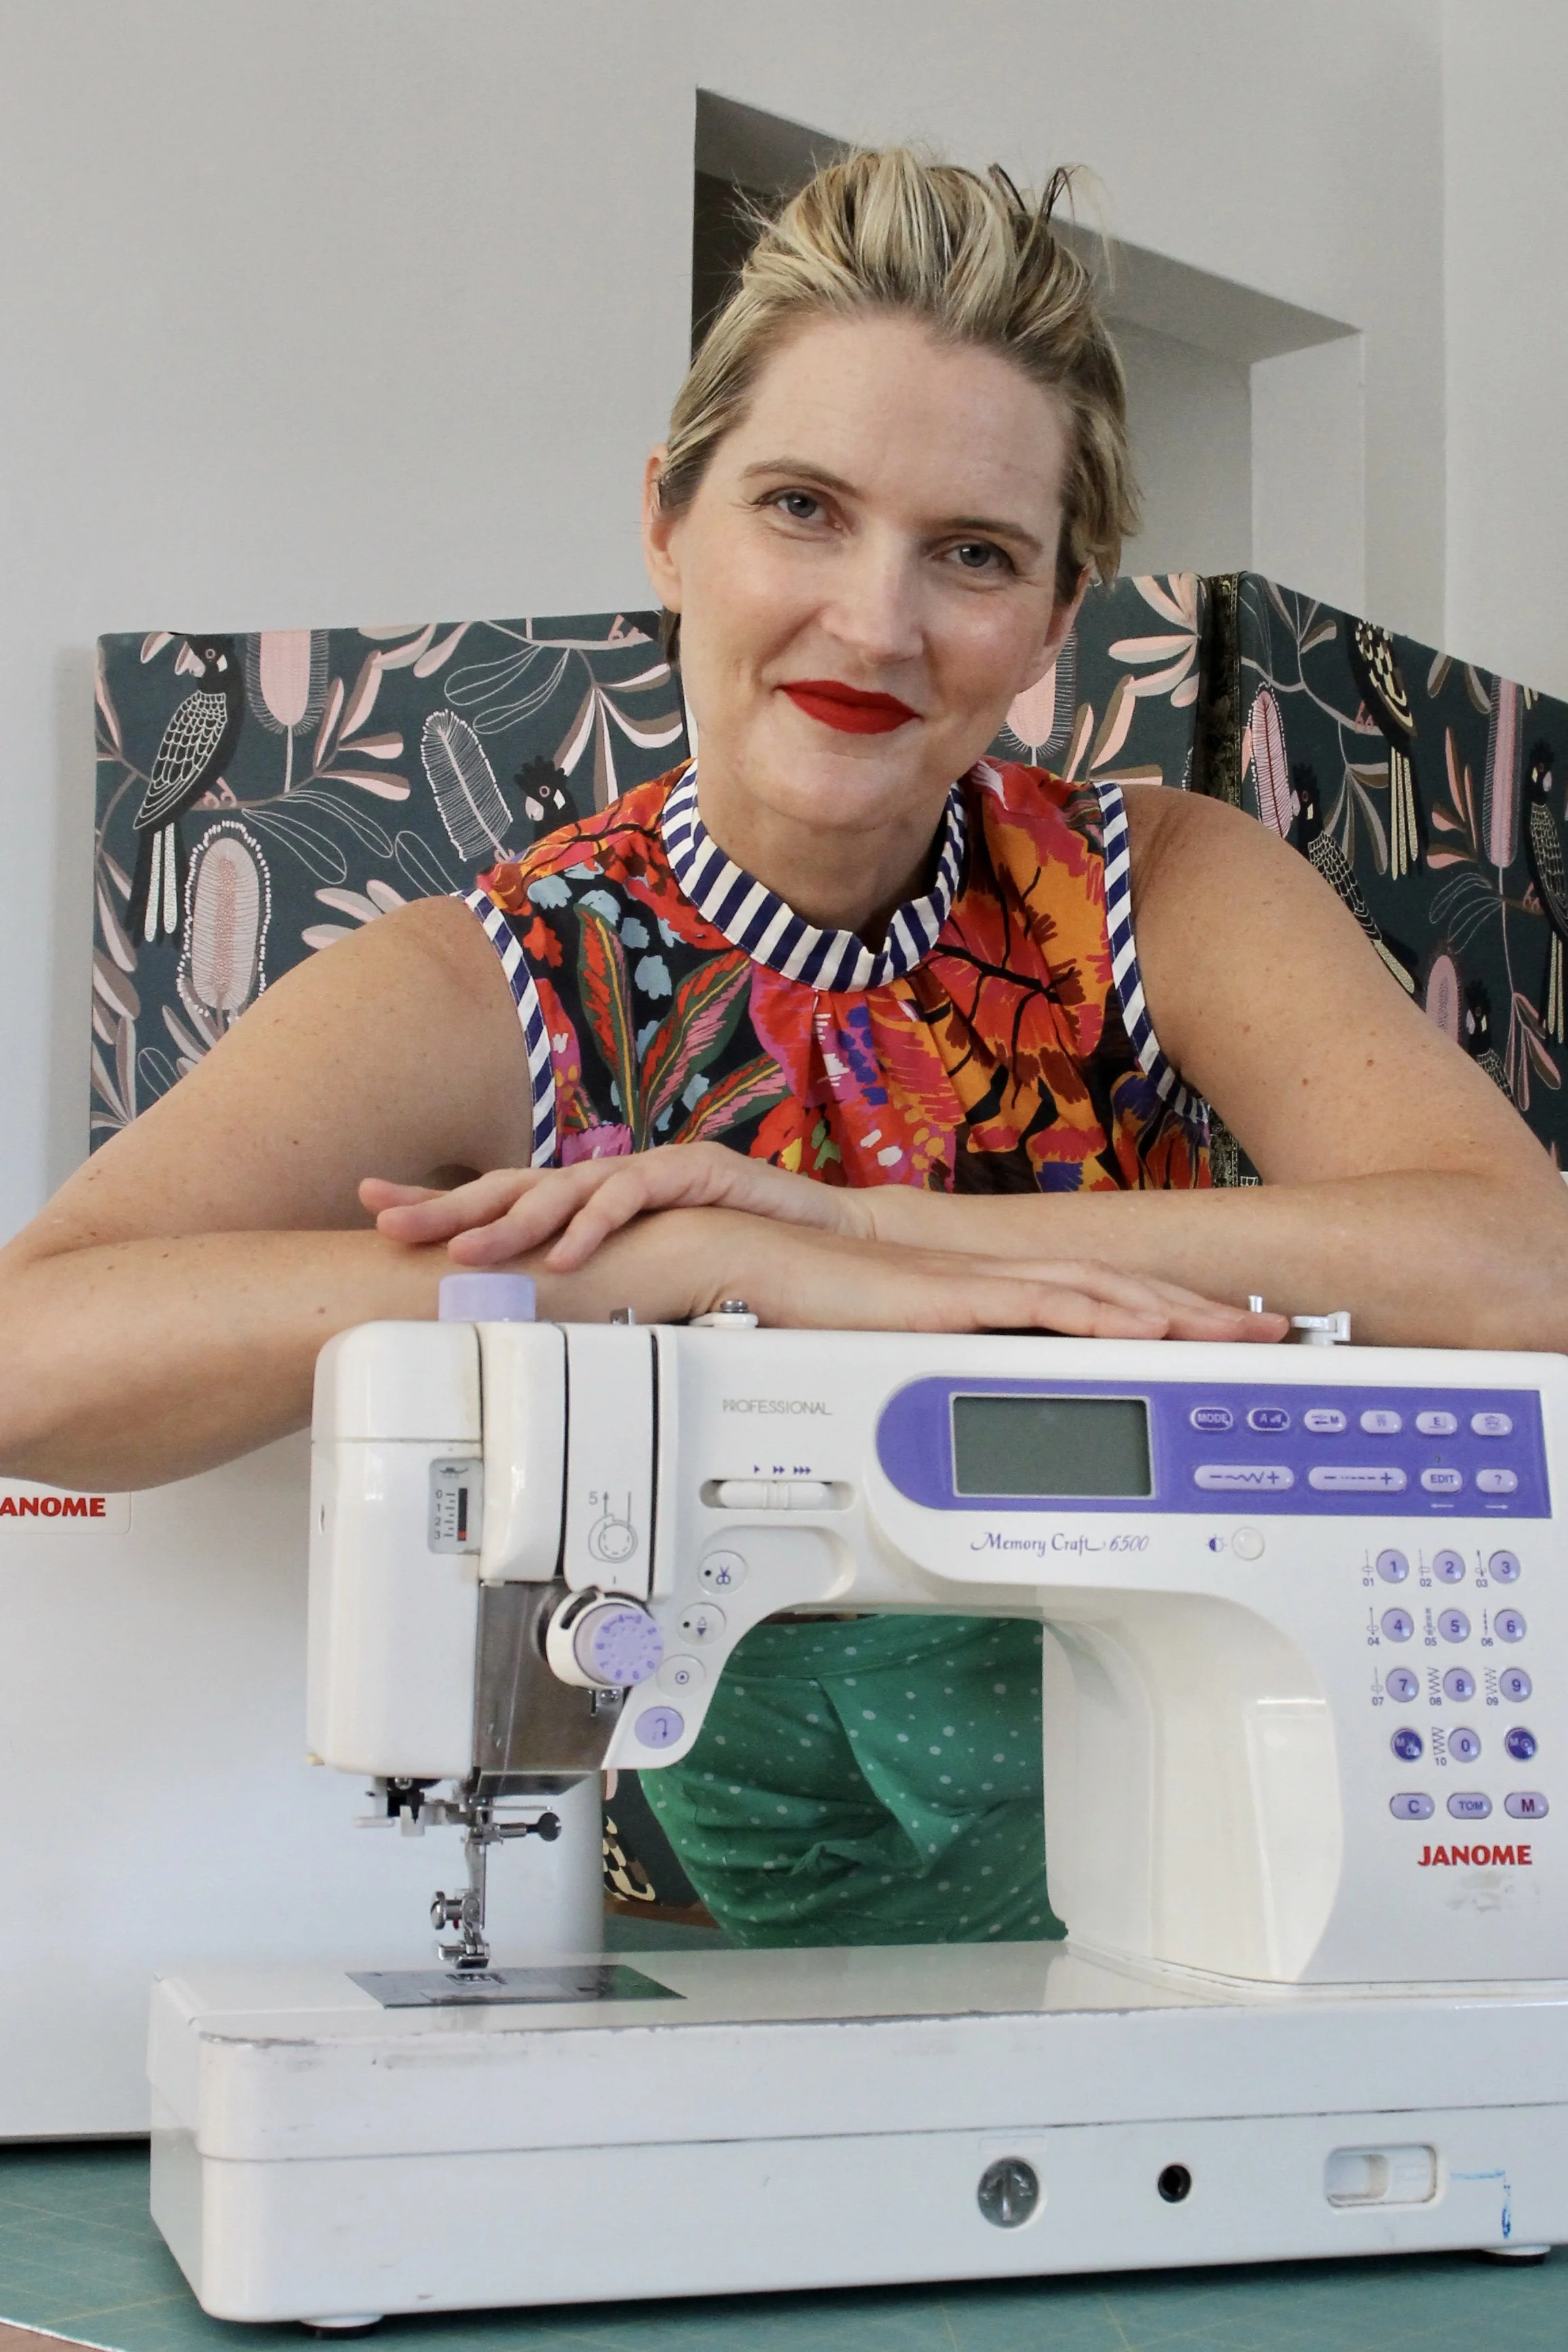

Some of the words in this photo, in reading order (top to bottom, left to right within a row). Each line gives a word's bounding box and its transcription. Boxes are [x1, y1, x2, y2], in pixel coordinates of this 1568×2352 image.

[722, 1399, 833, 1416] PROFESSIONAL
[1430, 1474, 1454, 1484] EDIT
[588, 1491, 598, 1506] 5
[970, 1531, 1046, 1557] Memory
[1051, 1532, 1105, 1557] Craft
[1109, 1534, 1149, 1553] 6500
[1390, 1560, 1397, 1573] 1
[1444, 1560, 1455, 1574] 2
[1501, 1561, 1511, 1574] 3
[1362, 1578, 1375, 1587] 01
[1419, 1578, 1432, 1588] 02
[1476, 1579, 1489, 1588] 03
[1394, 1619, 1402, 1633] 4
[1450, 1619, 1459, 1633] 5
[1506, 1620, 1516, 1633] 6
[1367, 1637, 1380, 1646] 04
[1424, 1637, 1437, 1647] 05
[1481, 1637, 1494, 1647] 06
[1398, 1678, 1408, 1692] 7
[1455, 1679, 1465, 1692] 8
[1511, 1678, 1521, 1692] 9
[1372, 1696, 1384, 1706] 07
[1429, 1696, 1442, 1706] 08
[1486, 1697, 1499, 1707] 09
[1461, 1738, 1470, 1753] 0
[1434, 1756, 1447, 1767] 10
[1408, 1800, 1420, 1815] C
[1521, 1798, 1535, 1813] M
[1417, 1844, 1533, 1867] JANOME
